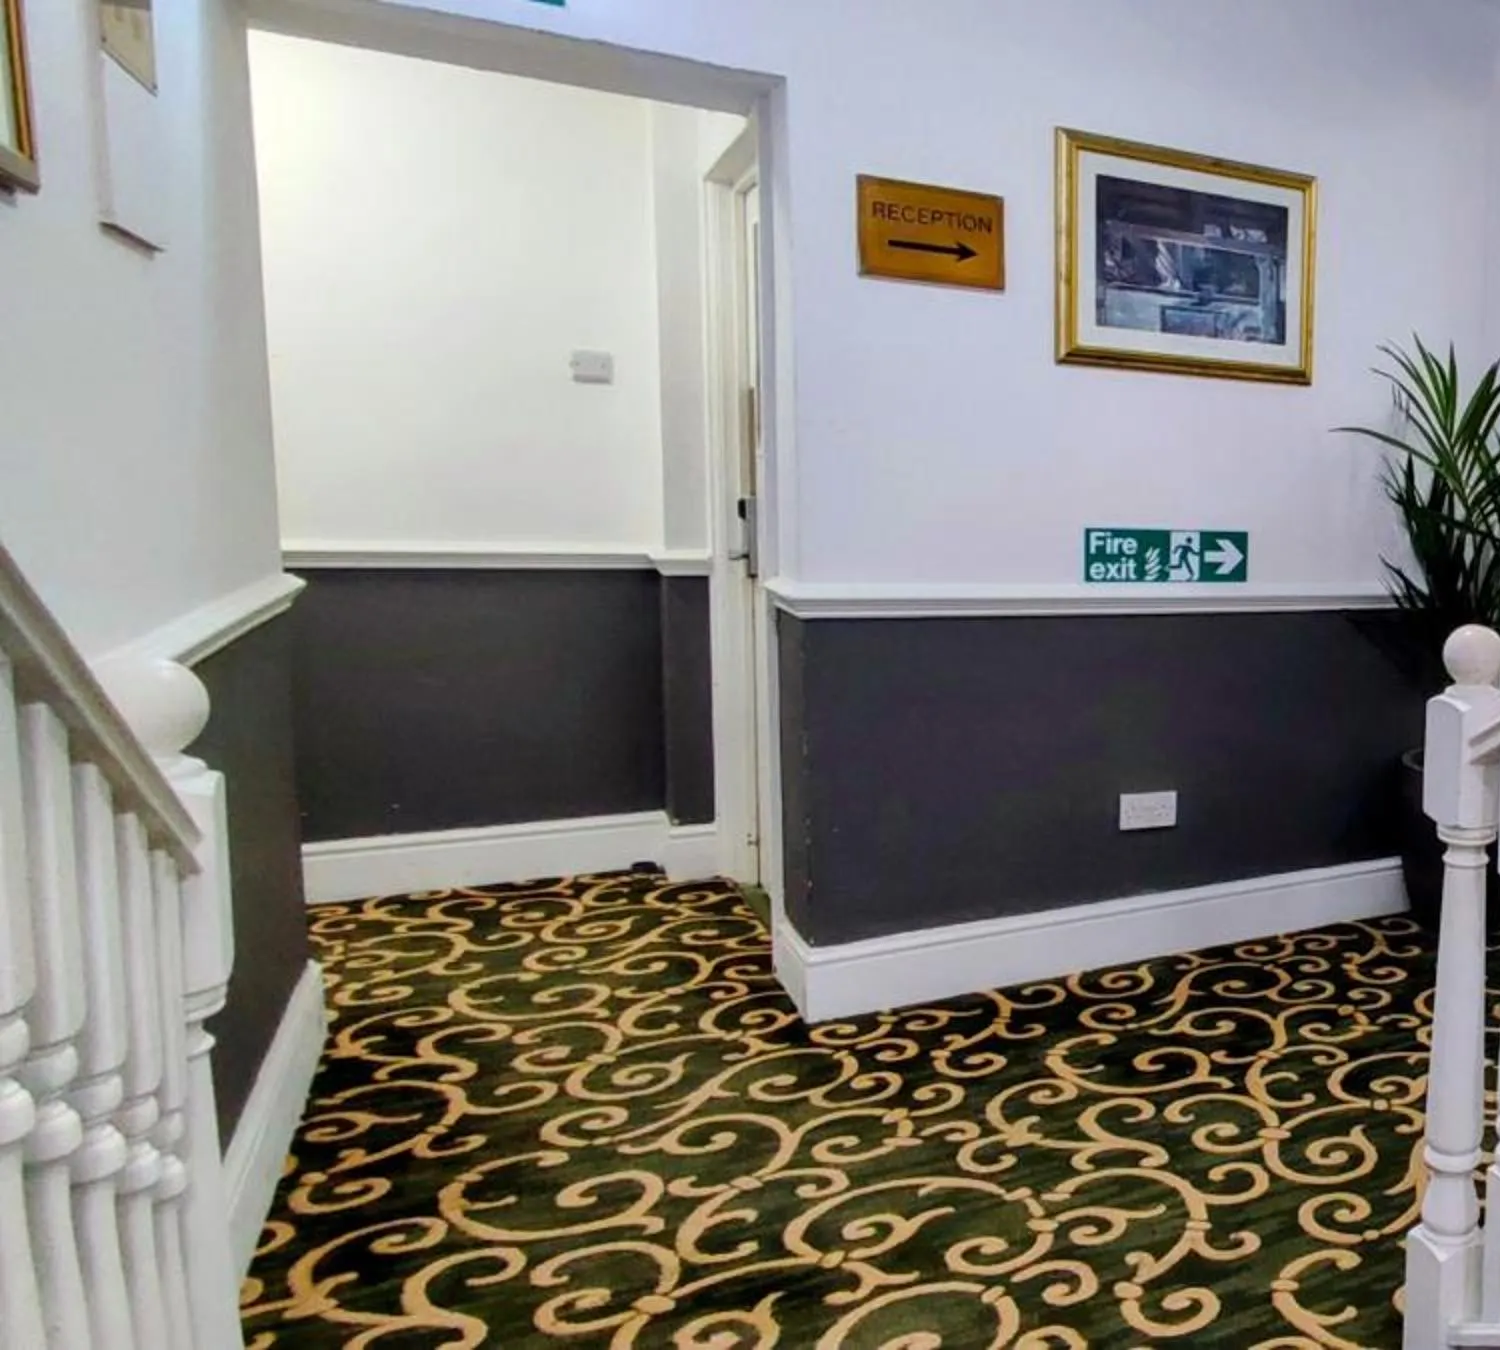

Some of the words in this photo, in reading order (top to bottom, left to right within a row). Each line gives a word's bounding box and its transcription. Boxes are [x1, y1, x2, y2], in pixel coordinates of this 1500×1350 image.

[872, 200, 993, 233] RECEPTION
[1089, 531, 1138, 555] Fire
[1089, 557, 1137, 580] exit
